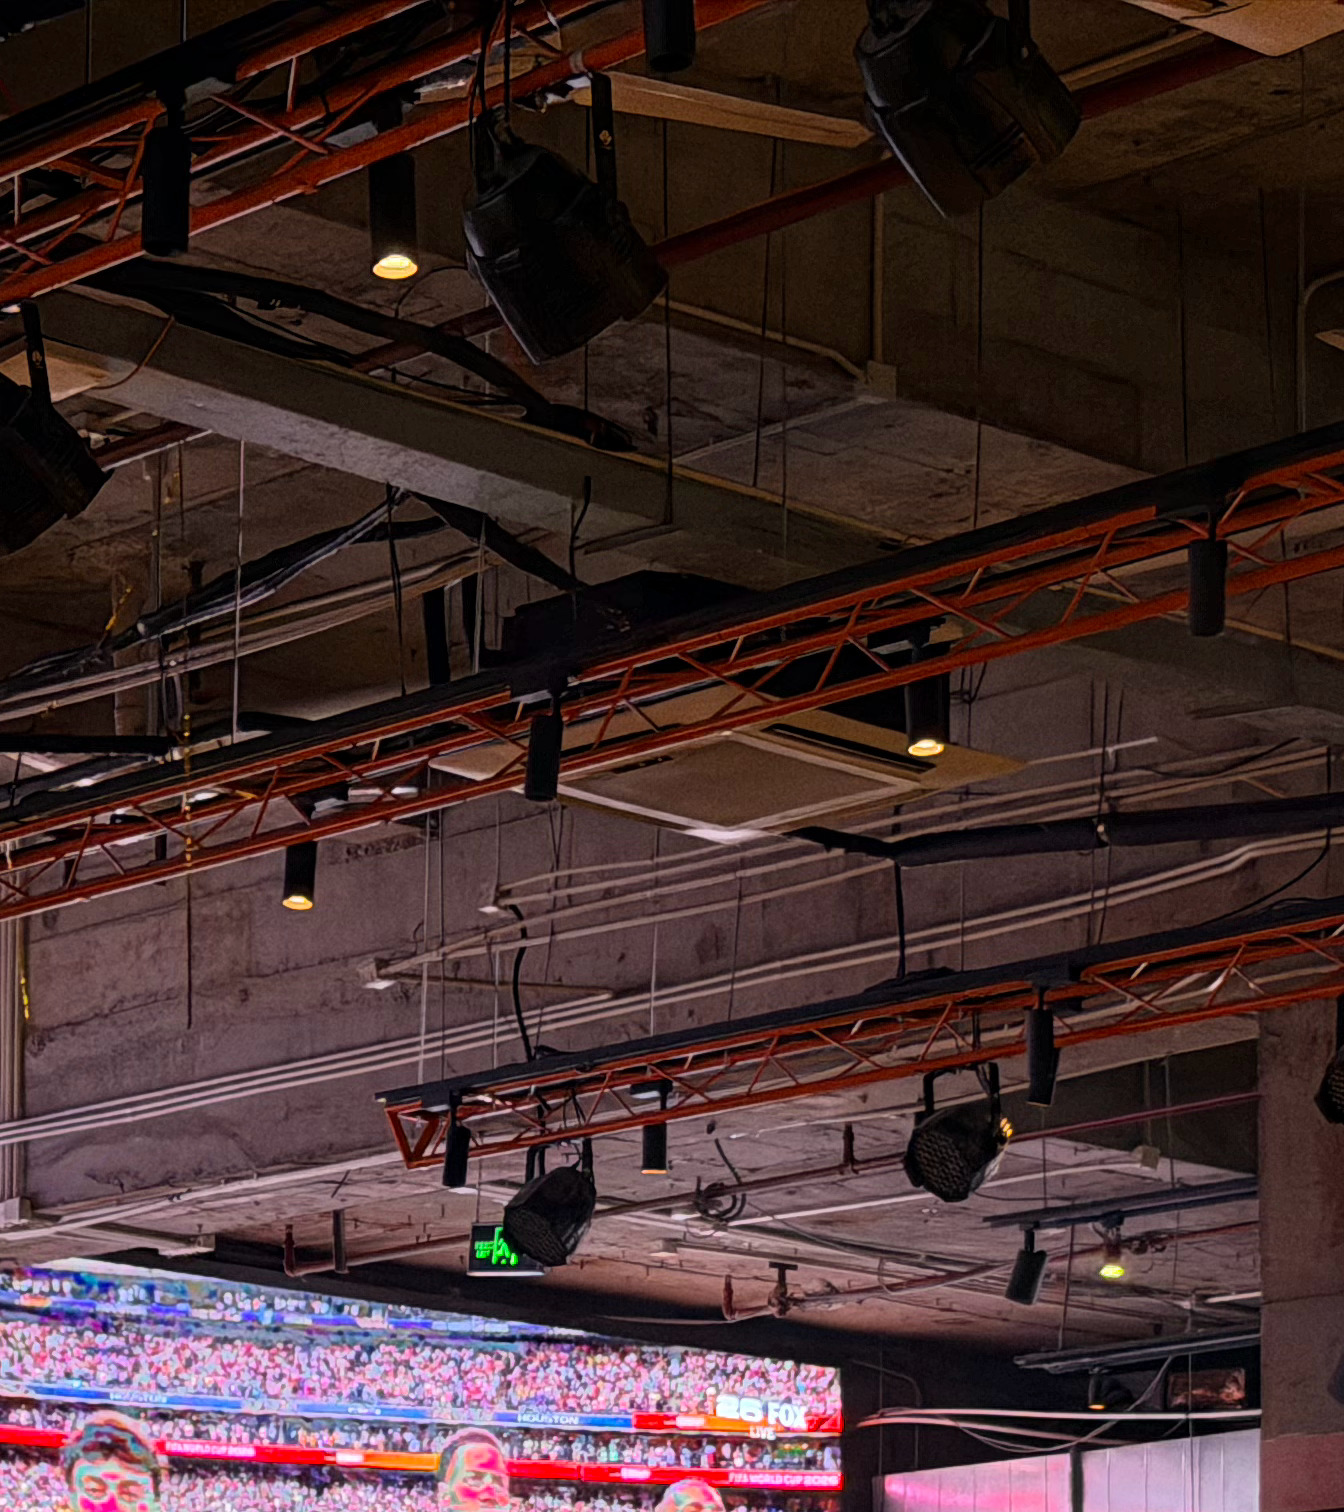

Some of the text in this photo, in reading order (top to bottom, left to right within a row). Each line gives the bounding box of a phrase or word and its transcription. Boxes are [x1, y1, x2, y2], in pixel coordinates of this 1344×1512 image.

[517, 1412, 580, 1426] HOUSTON
[767, 1400, 807, 1430] FOX
[749, 1425, 777, 1441] LIVE
